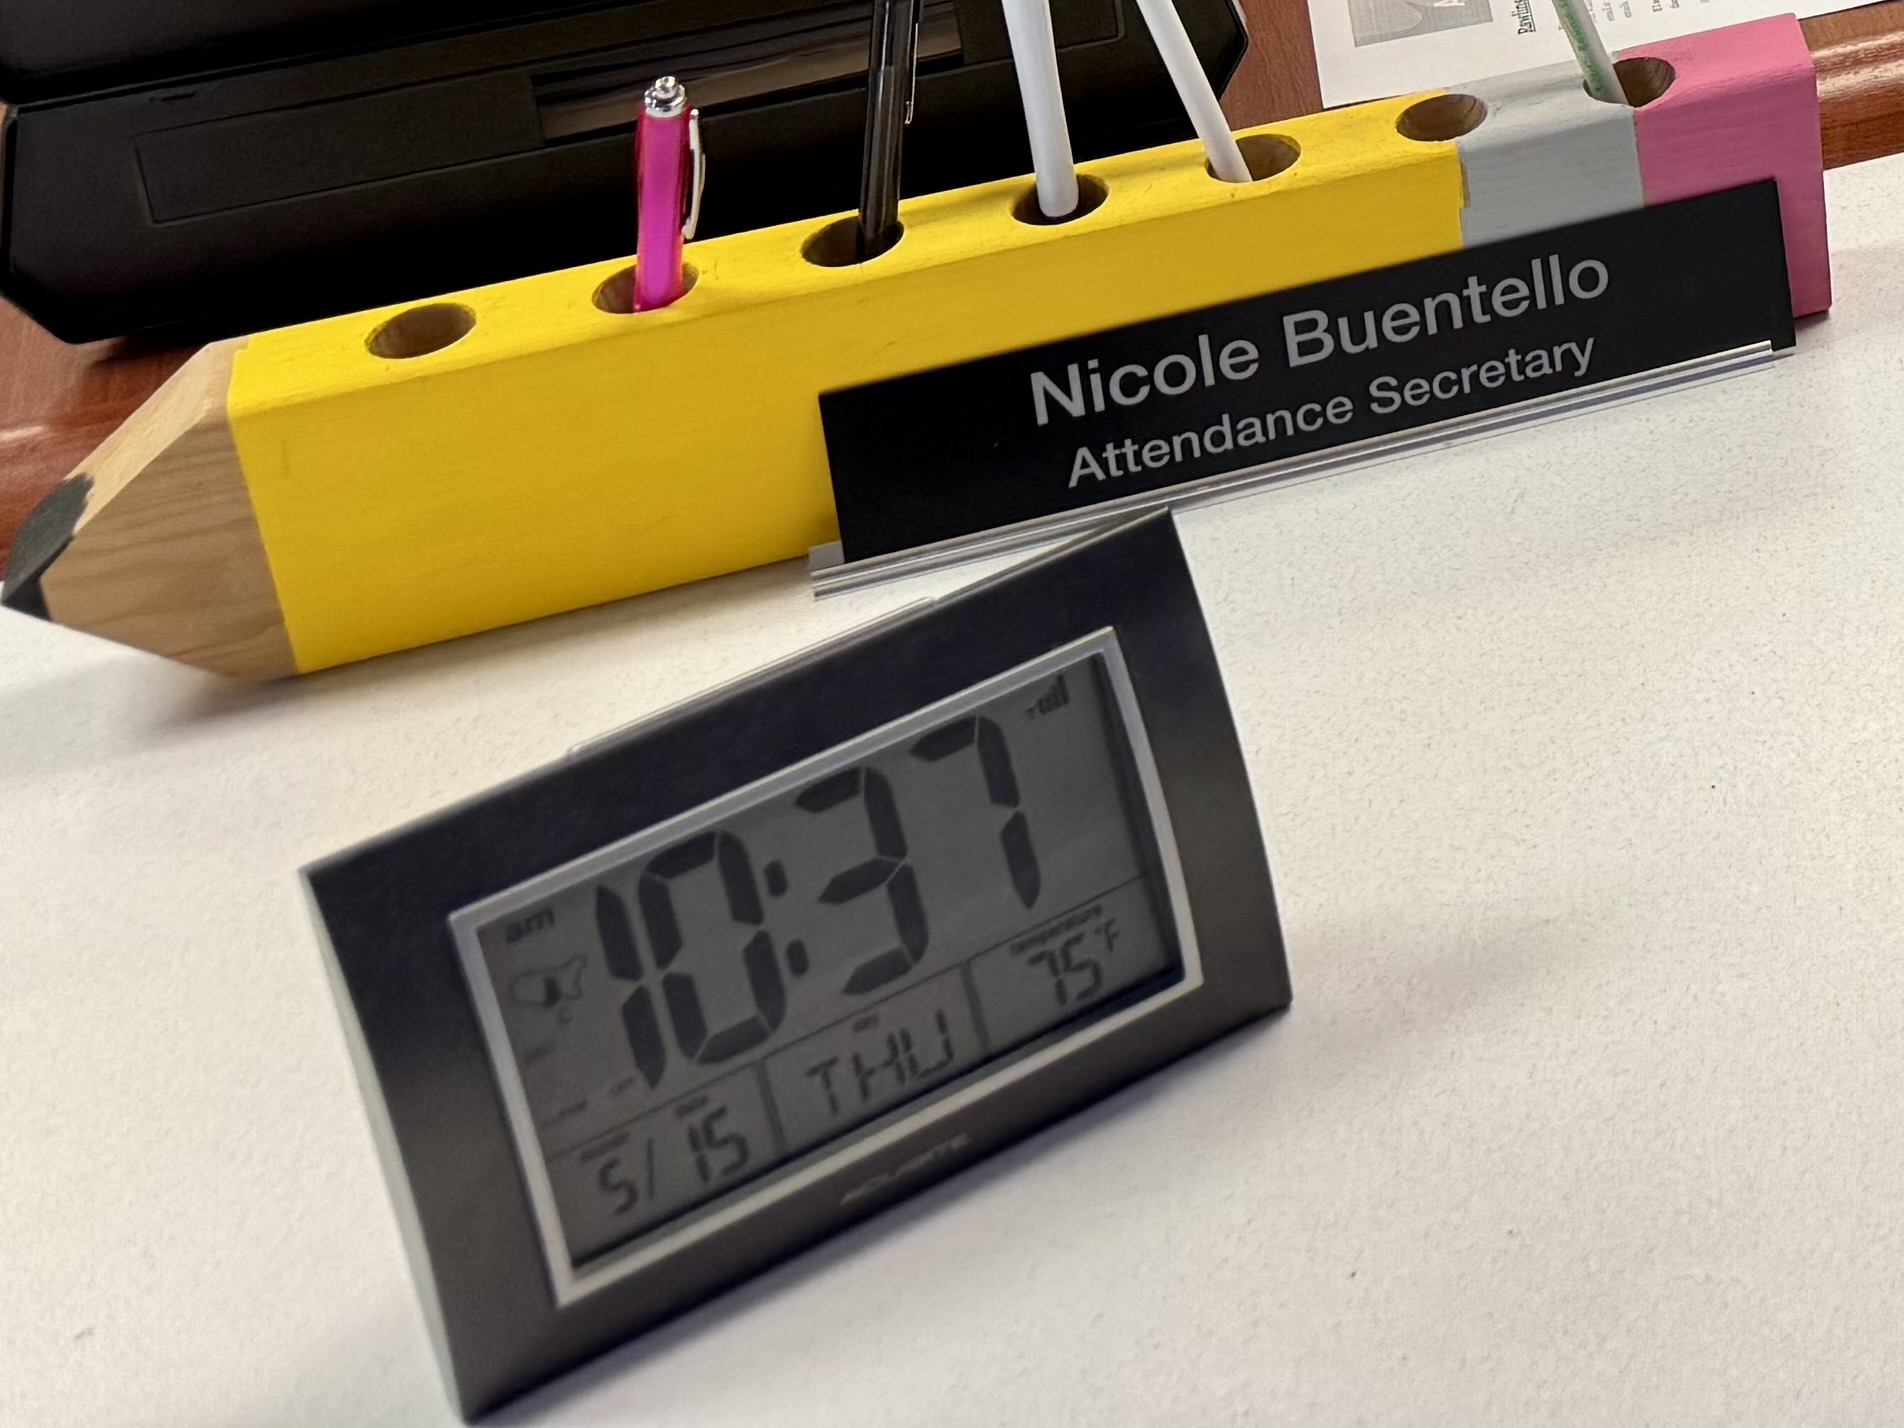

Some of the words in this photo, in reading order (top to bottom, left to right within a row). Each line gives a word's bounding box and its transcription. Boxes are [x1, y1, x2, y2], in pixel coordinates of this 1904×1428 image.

[1030, 334, 1259, 427] Nicole
[1283, 253, 1609, 367] Buentello
[1067, 392, 1354, 489] Attendance
[1368, 337, 1596, 415] Secretary
[594, 714, 1040, 1090] 10:37
[807, 1009, 957, 1116] THU
